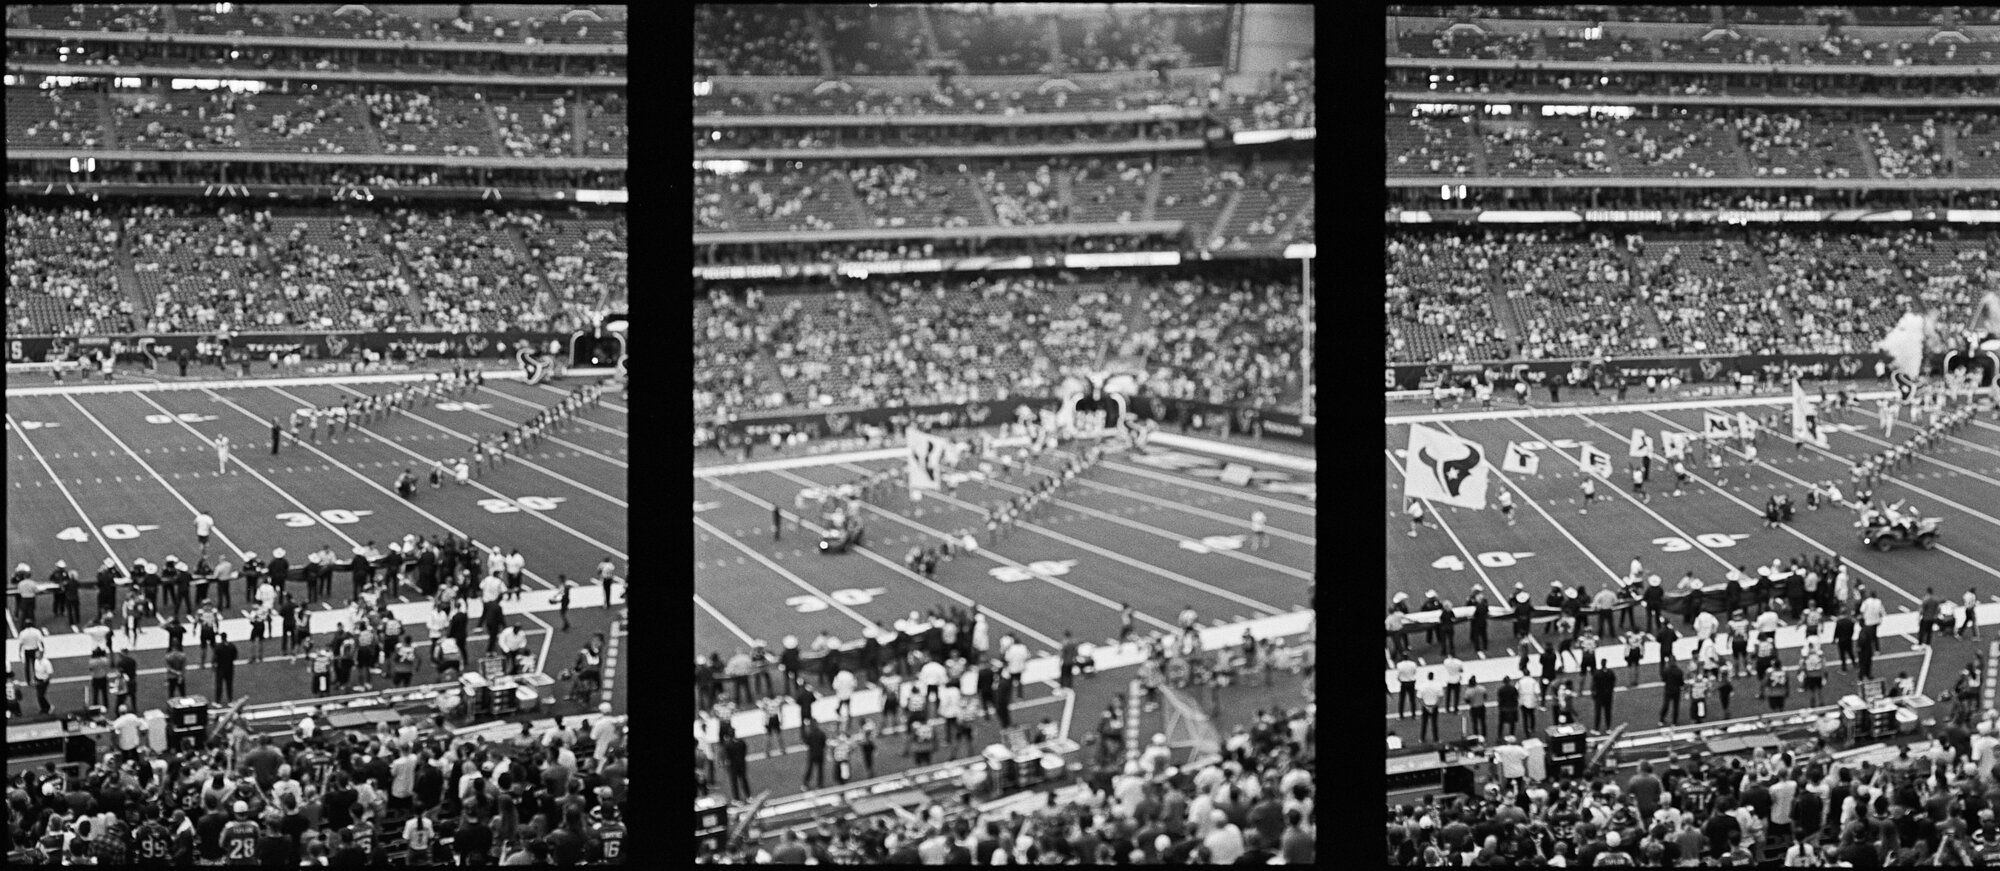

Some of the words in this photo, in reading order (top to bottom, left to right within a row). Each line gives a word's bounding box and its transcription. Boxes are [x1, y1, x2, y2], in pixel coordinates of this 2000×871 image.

[275, 508, 361, 529] 30
[56, 523, 144, 544] 40
[1652, 533, 1738, 553] 30
[1432, 550, 1518, 572] 40
[229, 838, 255, 860] 28
